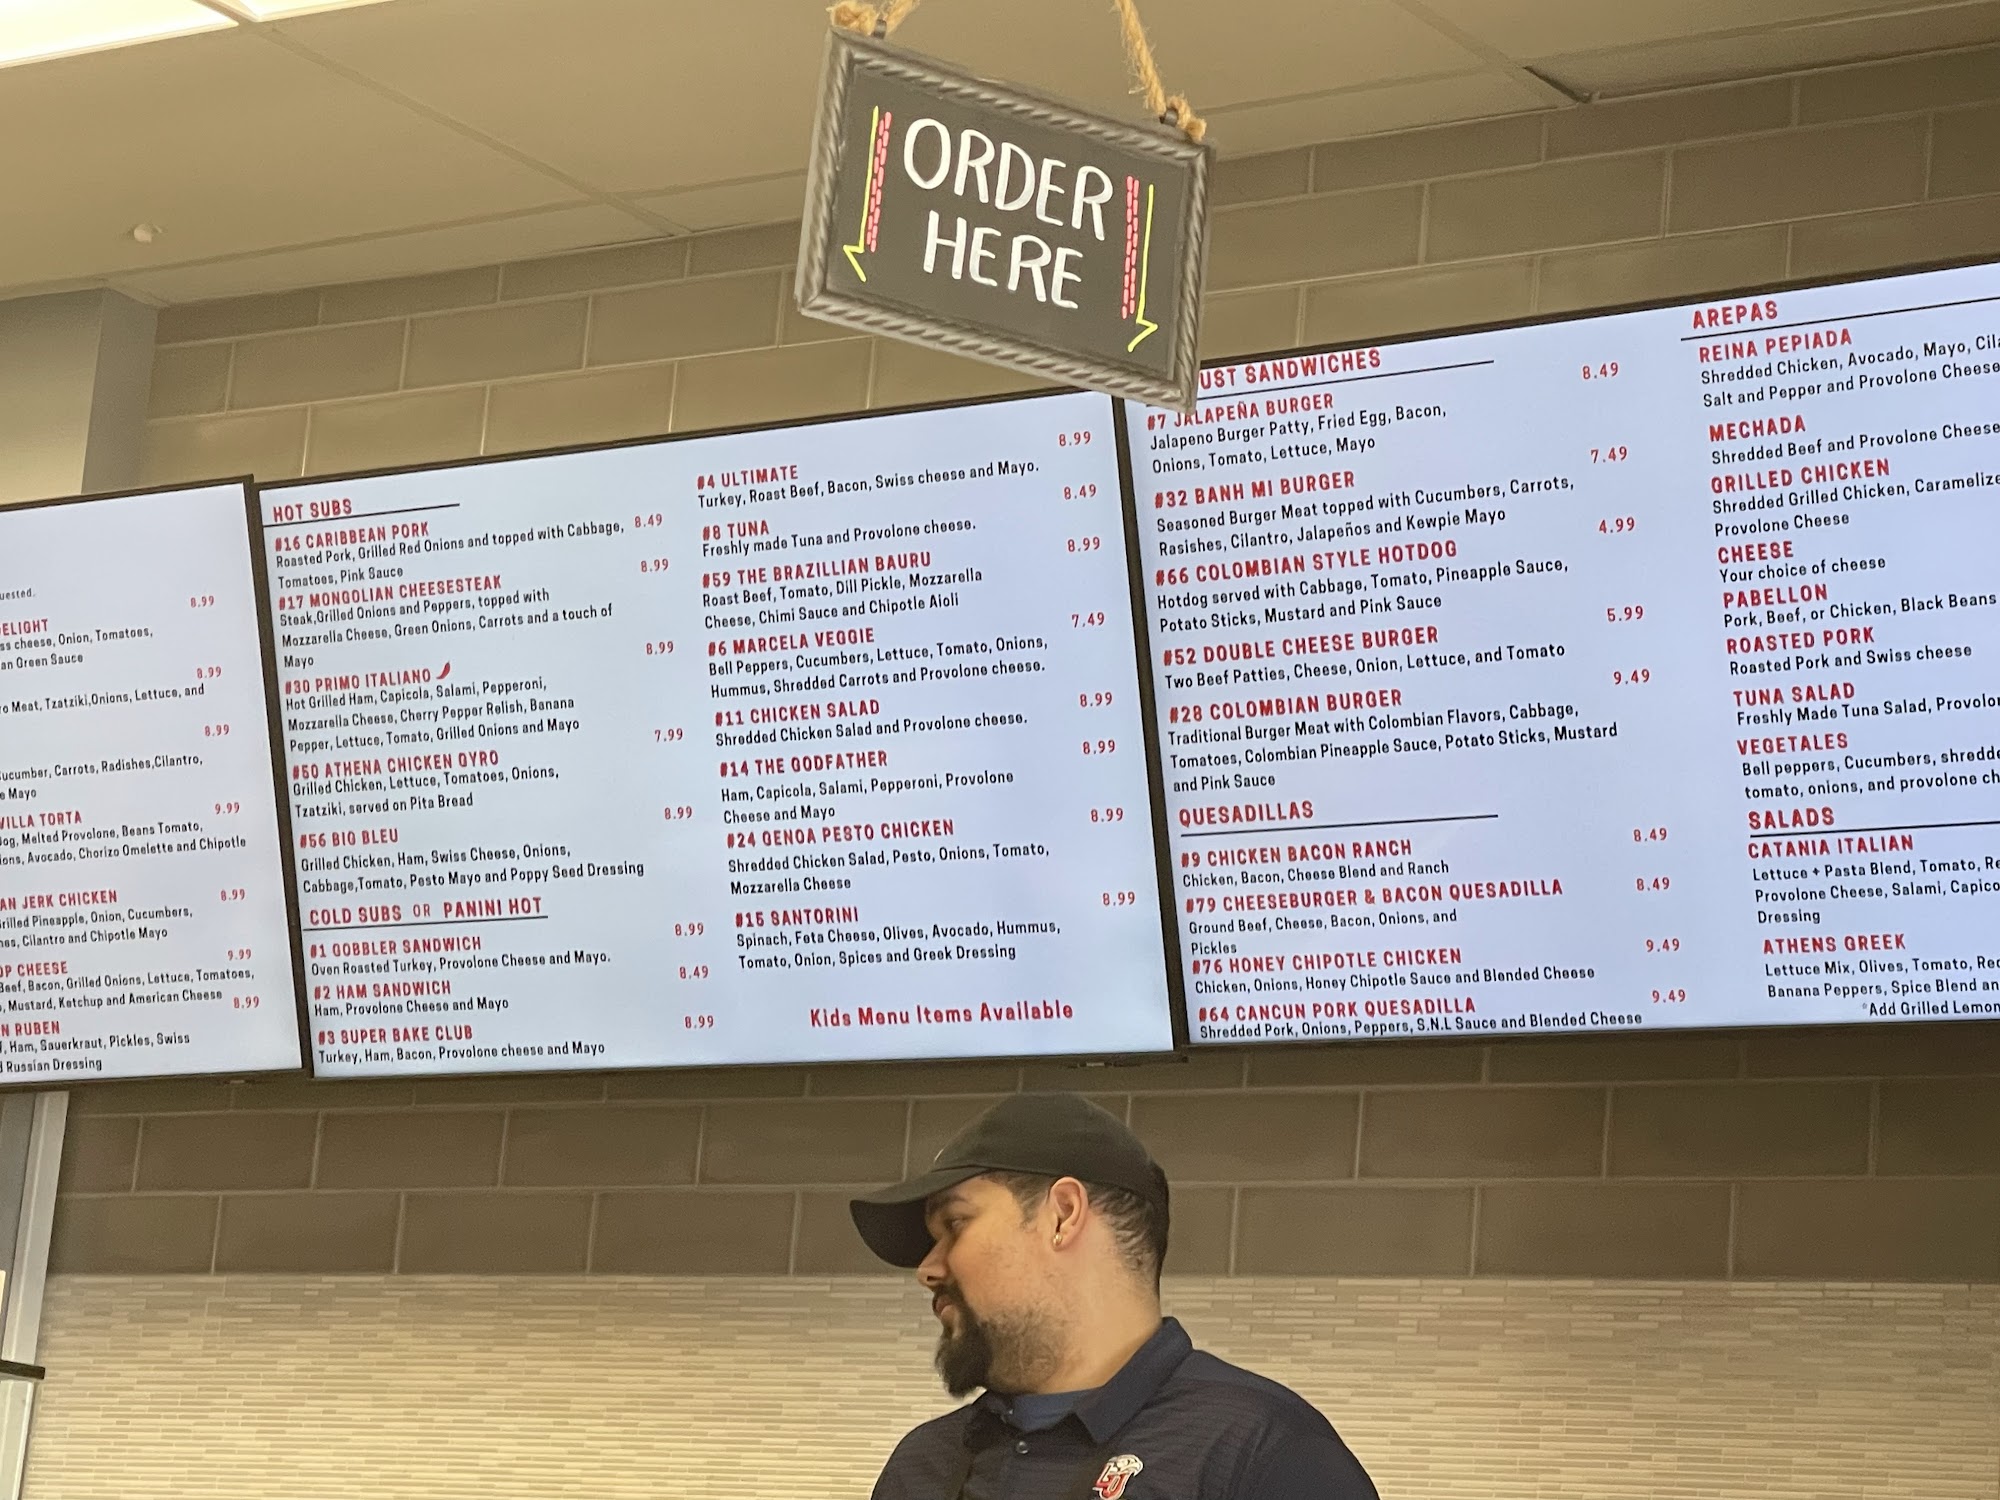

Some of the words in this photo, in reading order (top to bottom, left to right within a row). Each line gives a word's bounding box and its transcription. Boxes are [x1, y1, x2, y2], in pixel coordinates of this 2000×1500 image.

[902, 118, 1114, 241] ORDER
[922, 210, 1084, 310] HERE
[1692, 299, 1778, 330] AREPAS
[1698, 340, 1758, 364] REINA
[1764, 327, 1852, 355] PEPIADA
[1244, 346, 1382, 385] SANDWICHES
[1582, 361, 1619, 380] 8.49
[1146, 413, 1166, 432] #7
[1265, 392, 1333, 417] BURGER
[1058, 431, 1092, 447] 8.99
[1708, 414, 1806, 442] MECHADA
[1590, 446, 1628, 462] 7.49
[696, 474, 716, 491] #4
[720, 464, 797, 488] ULTIMATE
[1710, 468, 1793, 495] GRILLED
[1800, 458, 1890, 485] CHICKEN
[1063, 483, 1097, 500] 8.49
[1154, 489, 1188, 510] #32
[1194, 482, 1245, 506] BANH
[1250, 480, 1273, 498] MI
[1279, 470, 1355, 496] BURGER
[272, 502, 303, 522] HOT
[309, 497, 352, 520] SUBS
[634, 514, 663, 528] 8.49
[702, 524, 721, 541] #8
[726, 519, 769, 538] TUNA
[1230, 531, 1293, 549] Cilantro,
[1296, 521, 1371, 543] Jalapeños
[1375, 515, 1402, 534] and
[1406, 510, 1460, 532] Kewpie
[1464, 508, 1506, 526] Mayo
[1598, 516, 1636, 534] 4.99
[1714, 518, 1790, 538] Provolone
[1793, 513, 1850, 529] Cheese
[274, 535, 301, 552] #16
[305, 526, 387, 549] CARIBBEAN
[390, 521, 428, 539] PORK
[1067, 536, 1101, 553] 8.99
[1154, 566, 1190, 587] #66
[1195, 555, 1306, 583] COLOMBIAN
[1312, 547, 1370, 571] STYLE
[1377, 538, 1458, 564] HOTDOG
[1717, 539, 1792, 565] CHEESE
[640, 559, 669, 573] 8.99
[701, 571, 731, 589] #59
[736, 567, 766, 584] THE
[772, 557, 869, 583] BRAZILLIAN
[874, 551, 931, 572] BAURU
[1719, 568, 1754, 584] Your
[1758, 562, 1807, 580] choice
[1811, 558, 1826, 575] of
[1831, 557, 1886, 573] cheese
[190, 595, 215, 608] 8.99
[1722, 583, 1828, 609] PABELLON
[1071, 611, 1105, 625] 7.49
[1606, 604, 1644, 622] 5.99
[645, 641, 674, 655] 8.99
[1162, 646, 1196, 667] #52
[1202, 639, 1275, 664] DOUBLE
[1281, 632, 1355, 656] CHEESE
[1361, 624, 1438, 650] BURGER
[1726, 631, 1816, 654] ROASTED
[1822, 626, 1874, 646] PORK
[1729, 656, 1792, 676] Roasted
[1795, 653, 1830, 671] Pork
[1834, 650, 1862, 667] and
[1866, 648, 1912, 665] Swiss
[1916, 644, 1972, 660] cheese
[196, 665, 222, 680] 8.99
[284, 679, 311, 696] #30
[314, 674, 360, 691] PRIMO
[365, 668, 431, 687] ITALIANO
[1613, 668, 1650, 685] 9.49
[1079, 691, 1113, 708] 8.99
[1732, 687, 1784, 707] TUNA
[1790, 681, 1855, 703] SALAD
[714, 710, 744, 728] #11
[749, 704, 821, 724] CHICKEN
[826, 698, 880, 719] SALAD
[1168, 704, 1203, 724] #28
[1209, 695, 1320, 721] COLOMBIAN
[1325, 688, 1402, 712] BURGER
[204, 724, 230, 737] 8.99
[655, 728, 684, 739] 7.99
[1082, 740, 1116, 755] 8.99
[214, 802, 240, 814] 9.99
[664, 806, 693, 820] 8.99
[1090, 807, 1124, 823] 8.99
[1178, 800, 1314, 828] QUESADILLAS
[1748, 805, 1835, 830] SALADS
[1633, 827, 1668, 842] 8.49
[1747, 838, 1830, 860] CATANIA
[1837, 834, 1914, 854] ITALIAN
[220, 888, 246, 902] 8.99
[730, 877, 800, 895] Mozzarella
[803, 876, 851, 891] Cheese
[1636, 876, 1670, 892] 8.49
[22, 894, 54, 910] JERK
[58, 889, 118, 908] CHICKEN
[1102, 891, 1136, 906] 8.99
[1184, 896, 1217, 914] #79
[1222, 888, 1357, 912] CHEESEBURGER
[1364, 888, 1376, 905] &
[1381, 884, 1443, 904] BACON
[1448, 878, 1563, 902] QUESADILLA
[309, 906, 352, 926] COLD
[357, 904, 402, 924] SUBS
[412, 903, 430, 918] OR
[442, 899, 502, 918] PANINI
[508, 896, 541, 915] HOT
[734, 911, 765, 928] #15
[770, 906, 859, 926] SANTORINI
[674, 922, 704, 936] 8.99
[227, 948, 252, 960] 9.99
[1645, 938, 1680, 952] 9.49
[1763, 936, 1837, 955] ATHENS
[1843, 933, 1904, 952] GREEK
[738, 954, 792, 970] Tomato,
[794, 951, 836, 968] Onion,
[838, 950, 882, 968] Spices
[886, 947, 910, 963] and
[913, 945, 953, 962] Greek
[956, 943, 1016, 961] Dressing
[27, 979, 64, 992] Bacon,
[66, 975, 102, 990] Grilled
[104, 974, 145, 988] Onions,
[147, 972, 194, 985] Lettuce,
[196, 968, 255, 982] Tomatoes,
[679, 965, 709, 980] 8.49
[232, 995, 260, 1009] 8.99
[314, 1003, 343, 1018] Ham,
[345, 1000, 404, 1016] Provolone
[406, 999, 449, 1013] Cheese
[452, 996, 474, 1011] and
[476, 996, 509, 1013] Mayo
[1651, 989, 1686, 1003] 9.49
[684, 1015, 714, 1029] 8.99
[810, 1008, 852, 1028] Kids
[857, 1006, 910, 1026] Menu
[916, 1005, 973, 1024] Items
[979, 999, 1074, 1022] Available
[316, 1030, 335, 1046] #3
[340, 1027, 387, 1045] SUPER
[391, 1025, 429, 1043] BAKE
[434, 1024, 473, 1041] CLUB
